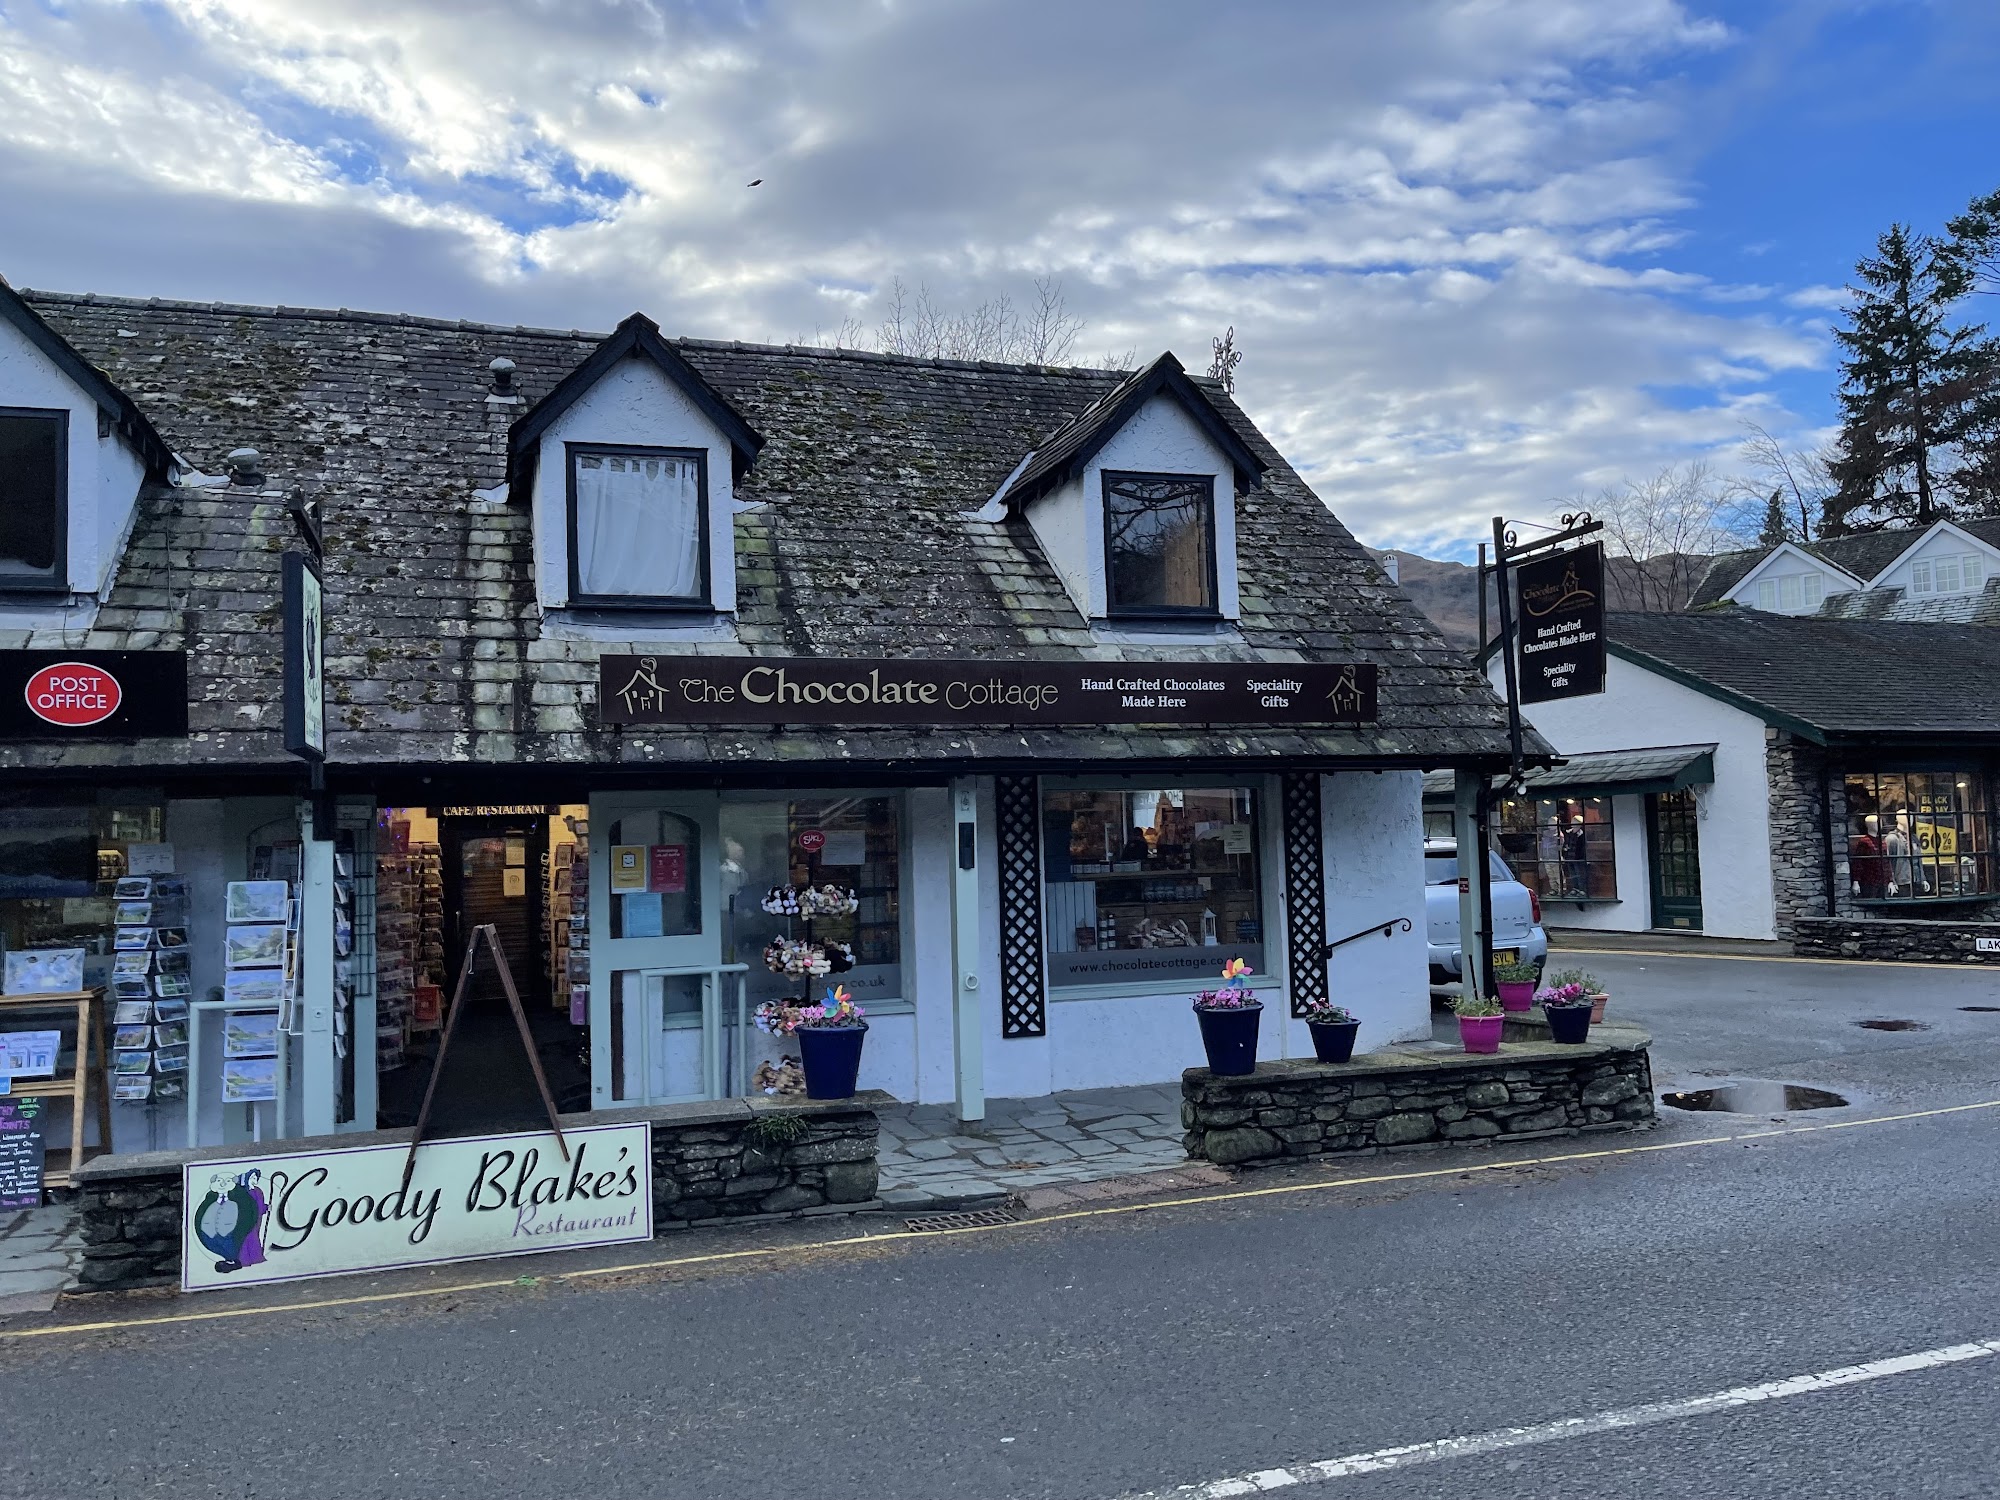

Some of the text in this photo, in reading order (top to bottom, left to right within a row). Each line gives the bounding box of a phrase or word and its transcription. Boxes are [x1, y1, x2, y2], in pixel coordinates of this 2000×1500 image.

[1537, 618, 1582, 639] Hand Crafted
[1524, 631, 1596, 654] Chocolates Made Here
[1543, 662, 1576, 678] Speciality
[49, 676, 102, 693] POST
[679, 666, 1059, 711] The Chocolate Cottage
[1081, 678, 1226, 692] Hand Crafted Chocolates
[1246, 679, 1303, 695] Speciality
[1551, 676, 1568, 688] Gifts
[37, 694, 107, 710] OFFICE
[1121, 695, 1187, 708] Made Here
[1261, 695, 1289, 708] Gifts
[269, 1143, 638, 1250] Goody Blake's
[512, 1204, 638, 1239] Restaurant
